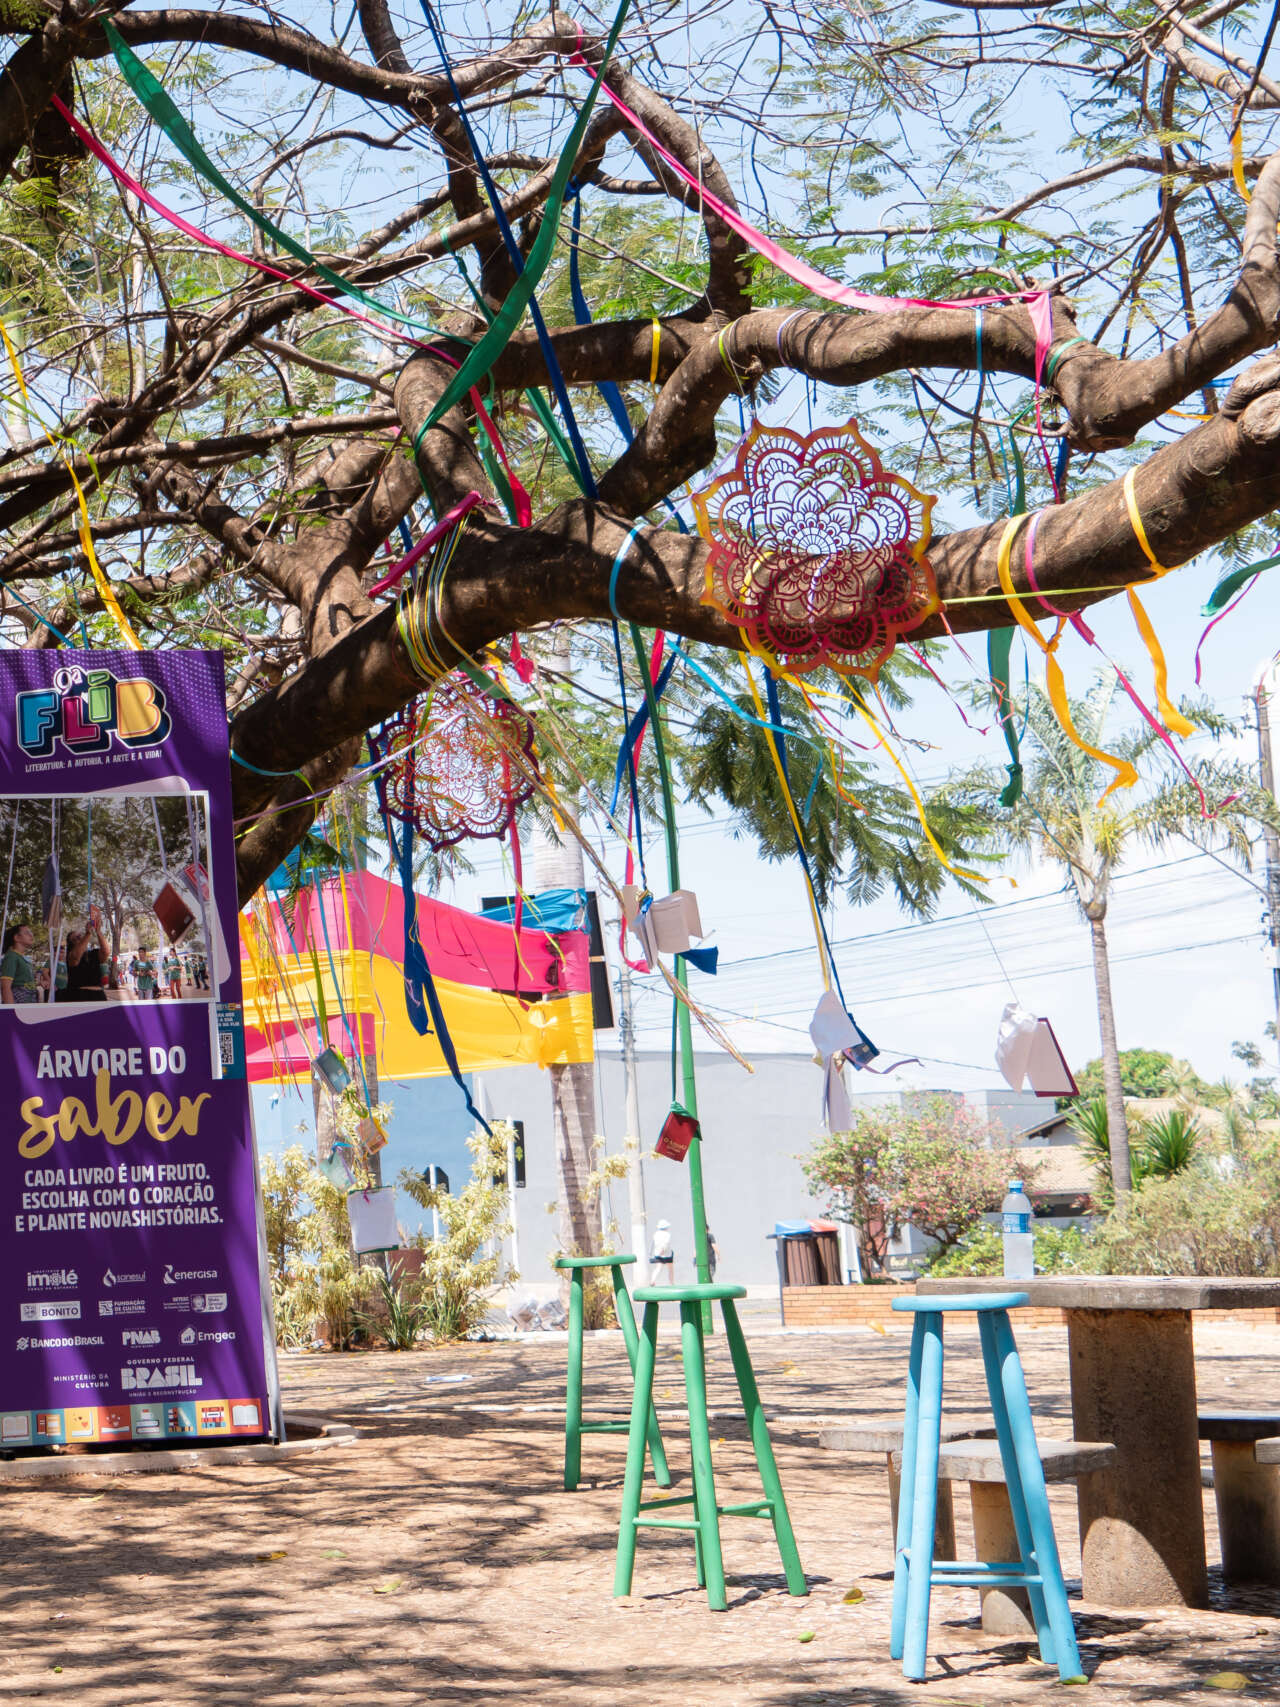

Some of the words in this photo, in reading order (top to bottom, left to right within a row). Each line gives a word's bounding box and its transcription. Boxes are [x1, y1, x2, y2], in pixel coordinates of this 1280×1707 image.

[112, 754, 129, 763] ARTE
[36, 1045, 143, 1079] ÁRVORE
[149, 1045, 187, 1075] DO
[18, 1067, 212, 1159] saber
[24, 1168, 66, 1187] CADA
[69, 1166, 115, 1186] LIVRO
[118, 1163, 127, 1184] É
[131, 1164, 155, 1183] UM
[157, 1163, 211, 1182] FRUTO.
[22, 1191, 90, 1210] ESCOLHA
[93, 1189, 126, 1208] COM
[129, 1187, 140, 1205] O
[144, 1184, 215, 1206] CORAÇÃO
[15, 1215, 25, 1232] E
[28, 1212, 86, 1231] PLANTE
[41, 1307, 79, 1317] BONITO
[122, 1330, 161, 1346] PNAB
[198, 1331, 236, 1343] Emgea
[163, 1356, 195, 1364] FEDERAL
[53, 1373, 97, 1382] MINISTÉRIO
[121, 1364, 203, 1390] BRASIL
